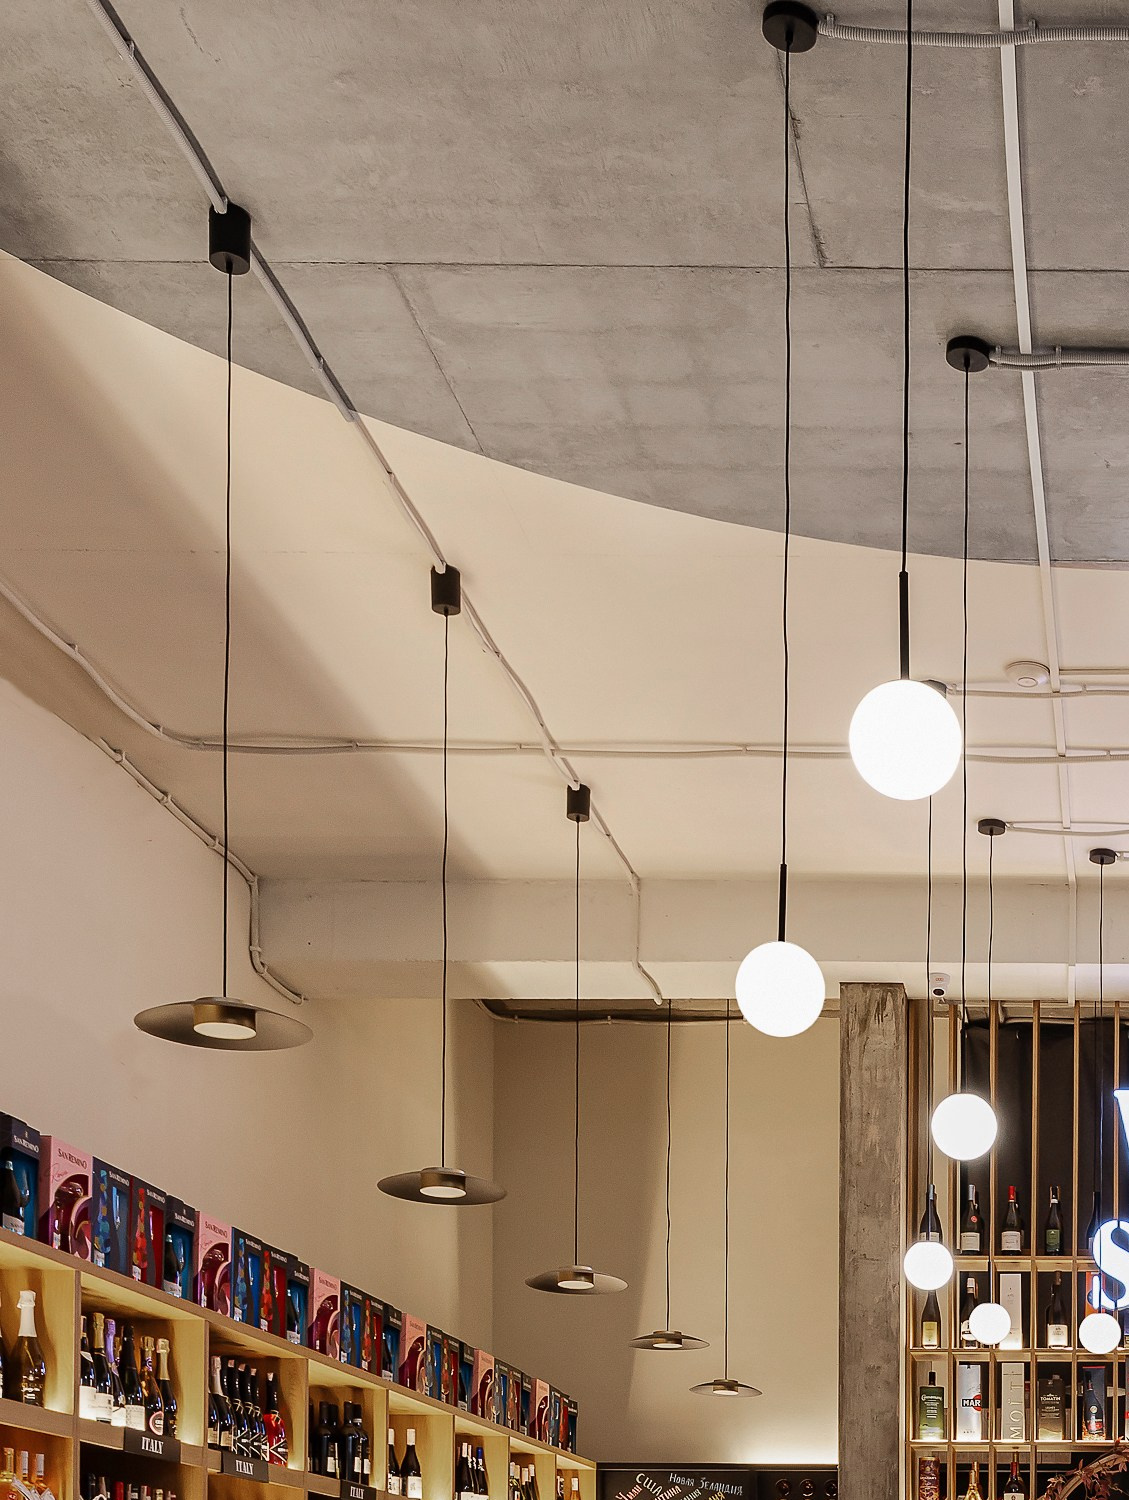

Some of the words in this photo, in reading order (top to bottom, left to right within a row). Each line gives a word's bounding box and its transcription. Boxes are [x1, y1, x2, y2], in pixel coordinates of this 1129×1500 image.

[141, 1436, 164, 1455] ITALY
[235, 1459, 254, 1476] ITALY
[635, 1473, 663, 1497] США
